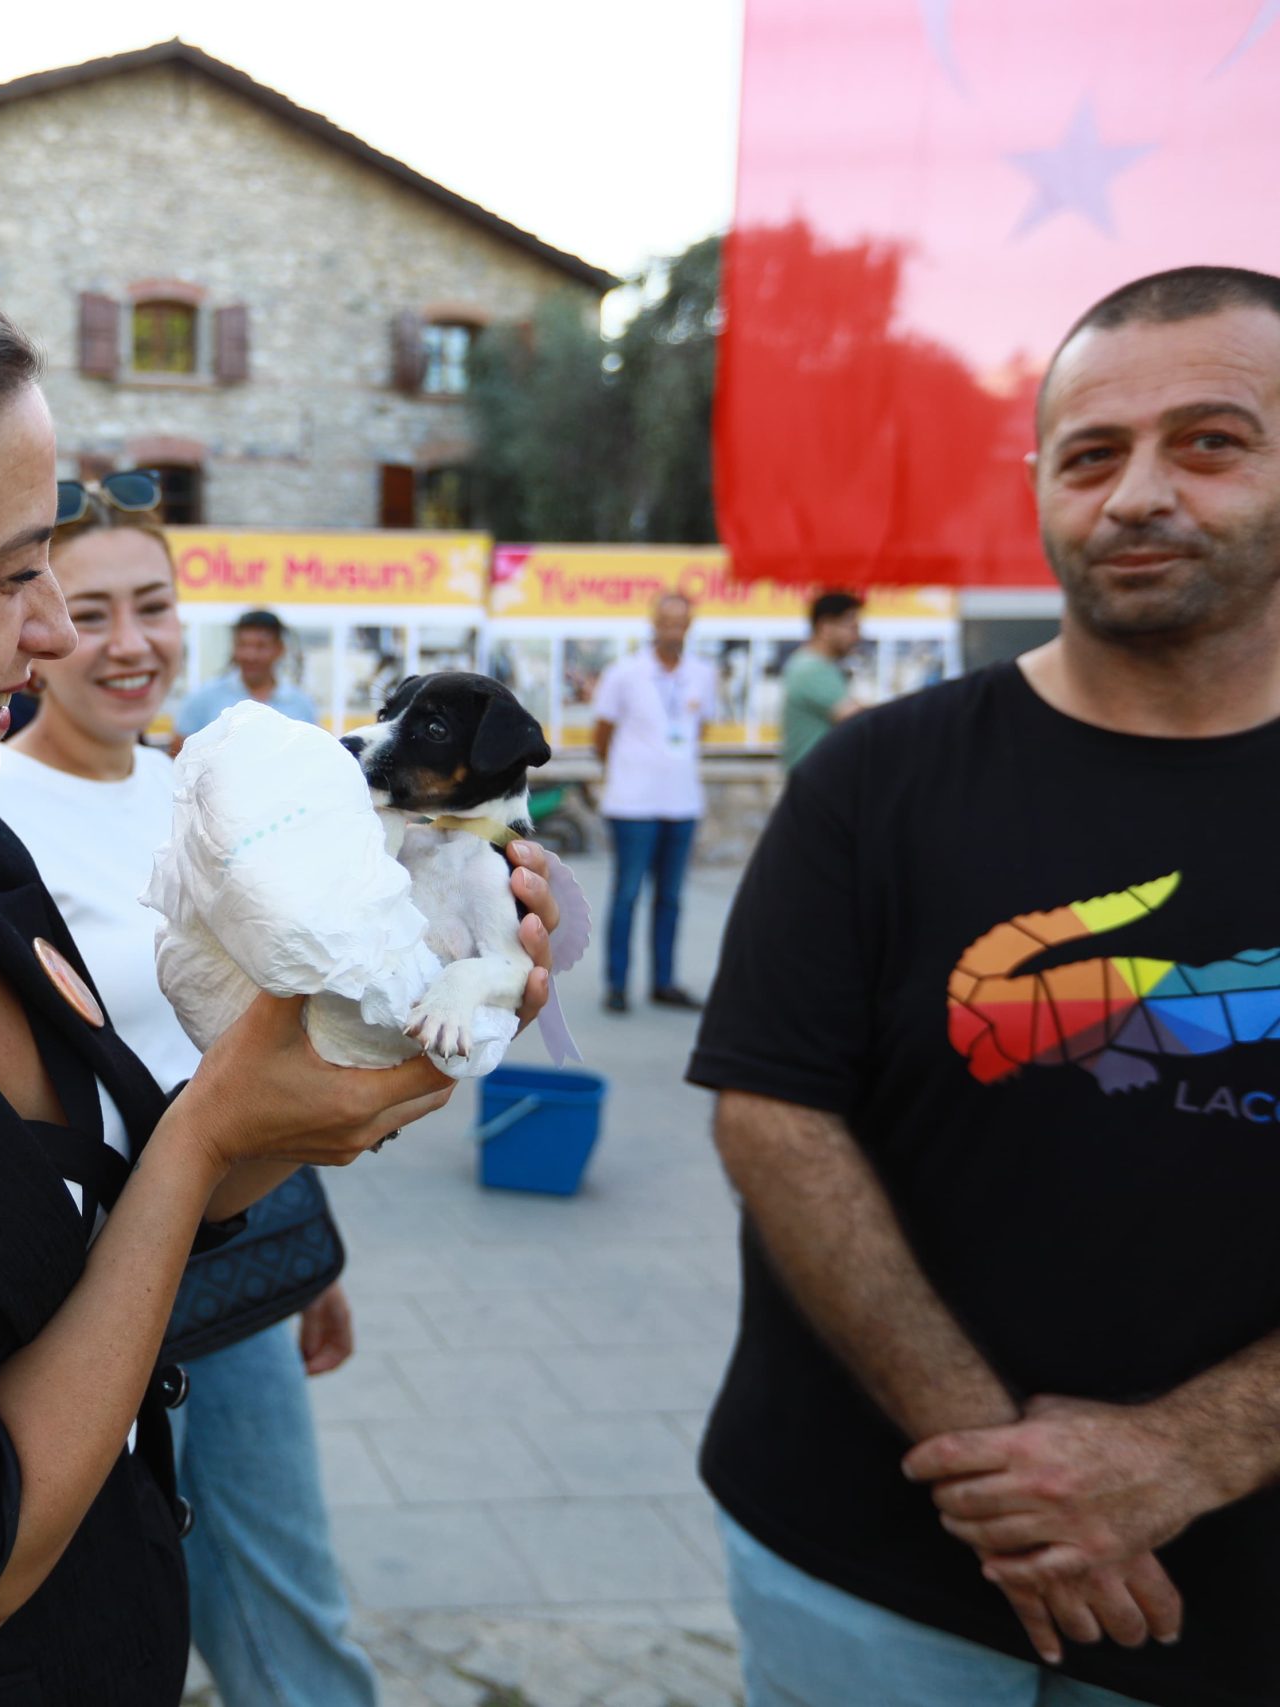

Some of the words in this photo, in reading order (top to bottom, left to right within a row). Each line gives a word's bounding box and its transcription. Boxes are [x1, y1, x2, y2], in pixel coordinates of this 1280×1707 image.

[179, 544, 267, 589] Olur
[283, 550, 440, 591] Musun?
[1174, 1080, 1280, 1124] LAC
